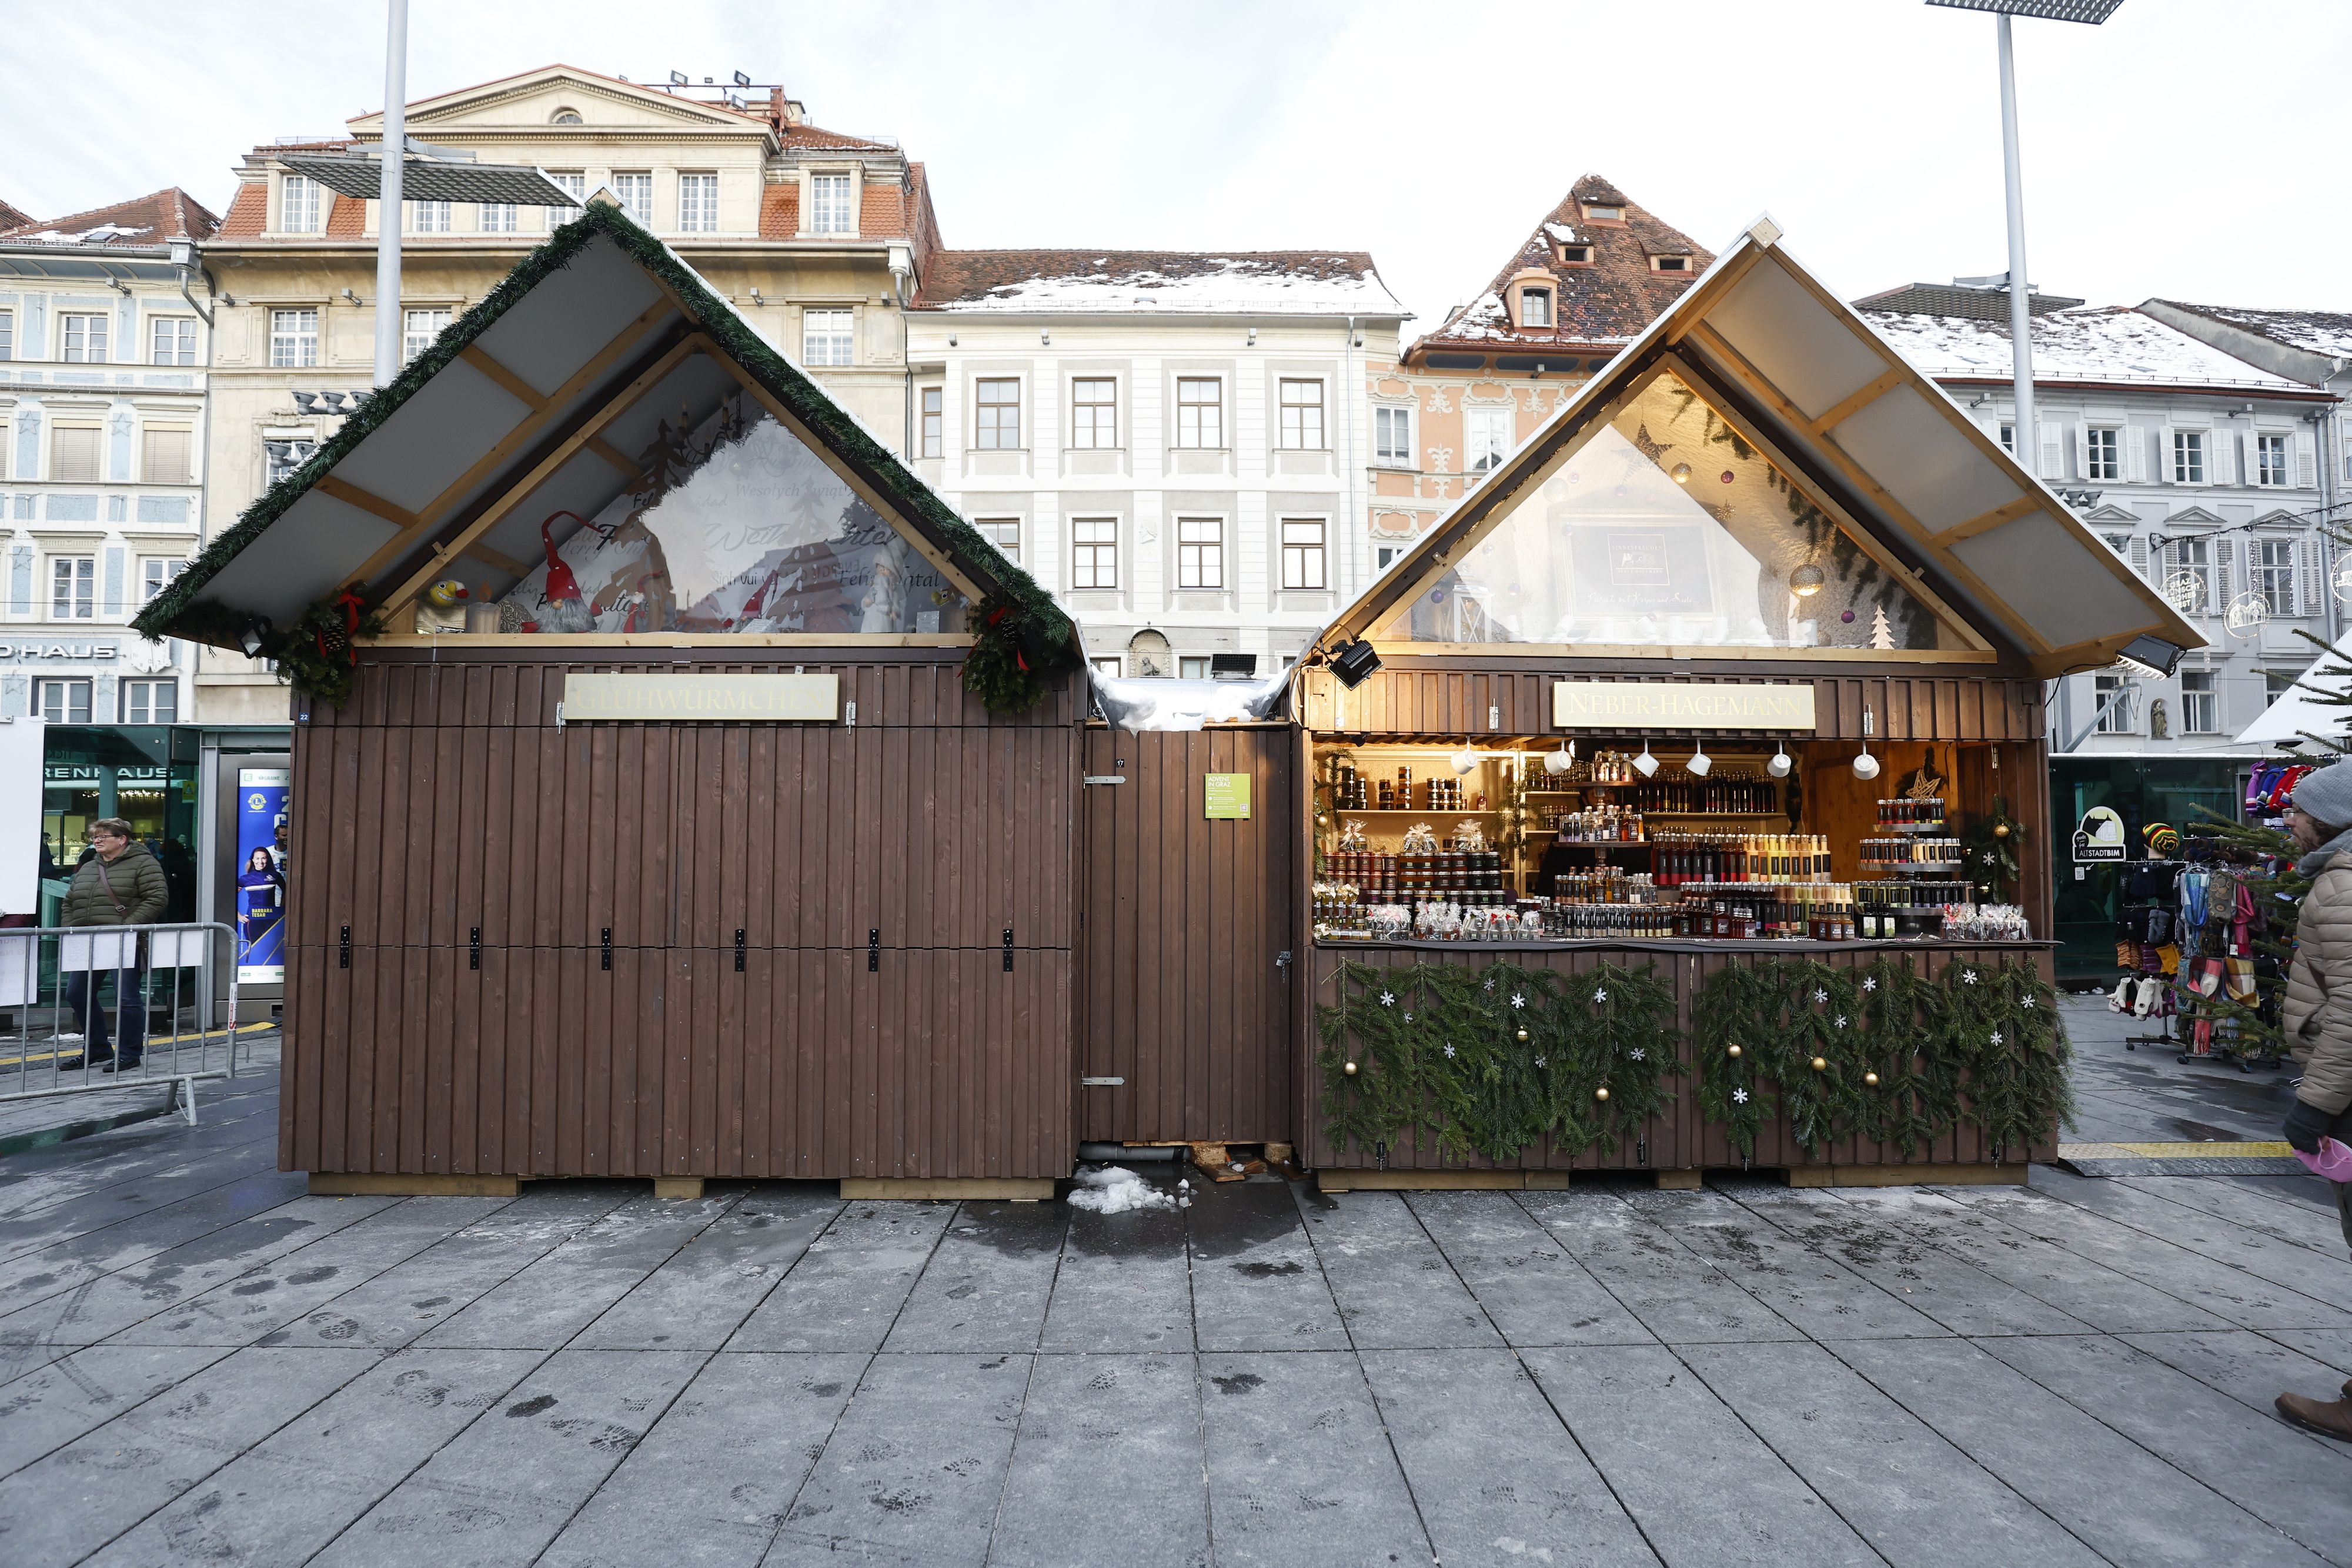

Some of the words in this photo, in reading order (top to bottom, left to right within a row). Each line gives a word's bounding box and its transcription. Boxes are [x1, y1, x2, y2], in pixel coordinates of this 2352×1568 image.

[2170, 577, 2191, 588] GRAZ
[575, 684, 827, 711] GLÜHWÜRMCHEN
[1568, 692, 1802, 716] NEBER-HAGEMANN
